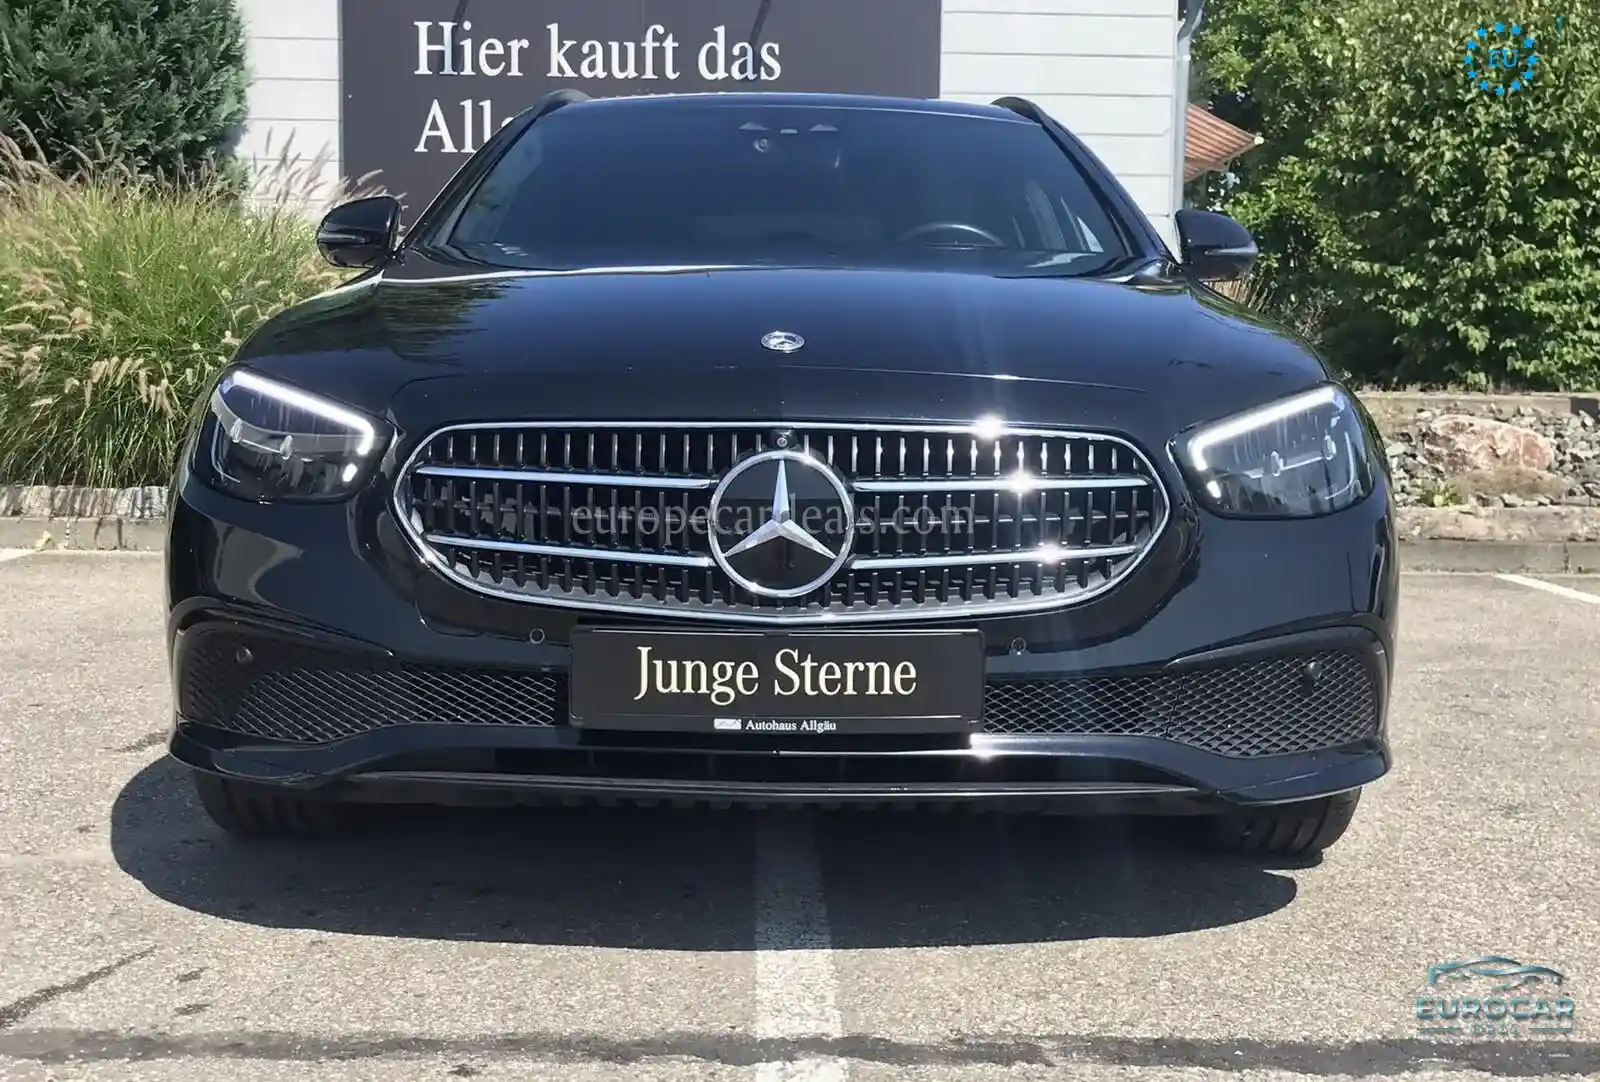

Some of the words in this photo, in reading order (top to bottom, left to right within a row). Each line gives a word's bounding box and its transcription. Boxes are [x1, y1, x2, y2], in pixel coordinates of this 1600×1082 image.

[414, 21, 529, 76] Hier
[546, 23, 681, 80] kauft
[698, 26, 782, 80] das
[414, 98, 514, 154] All
[633, 646, 759, 706] Junge
[774, 648, 917, 696] Sterne
[745, 719, 797, 731] Autohaus
[800, 719, 837, 733] Allgäu
